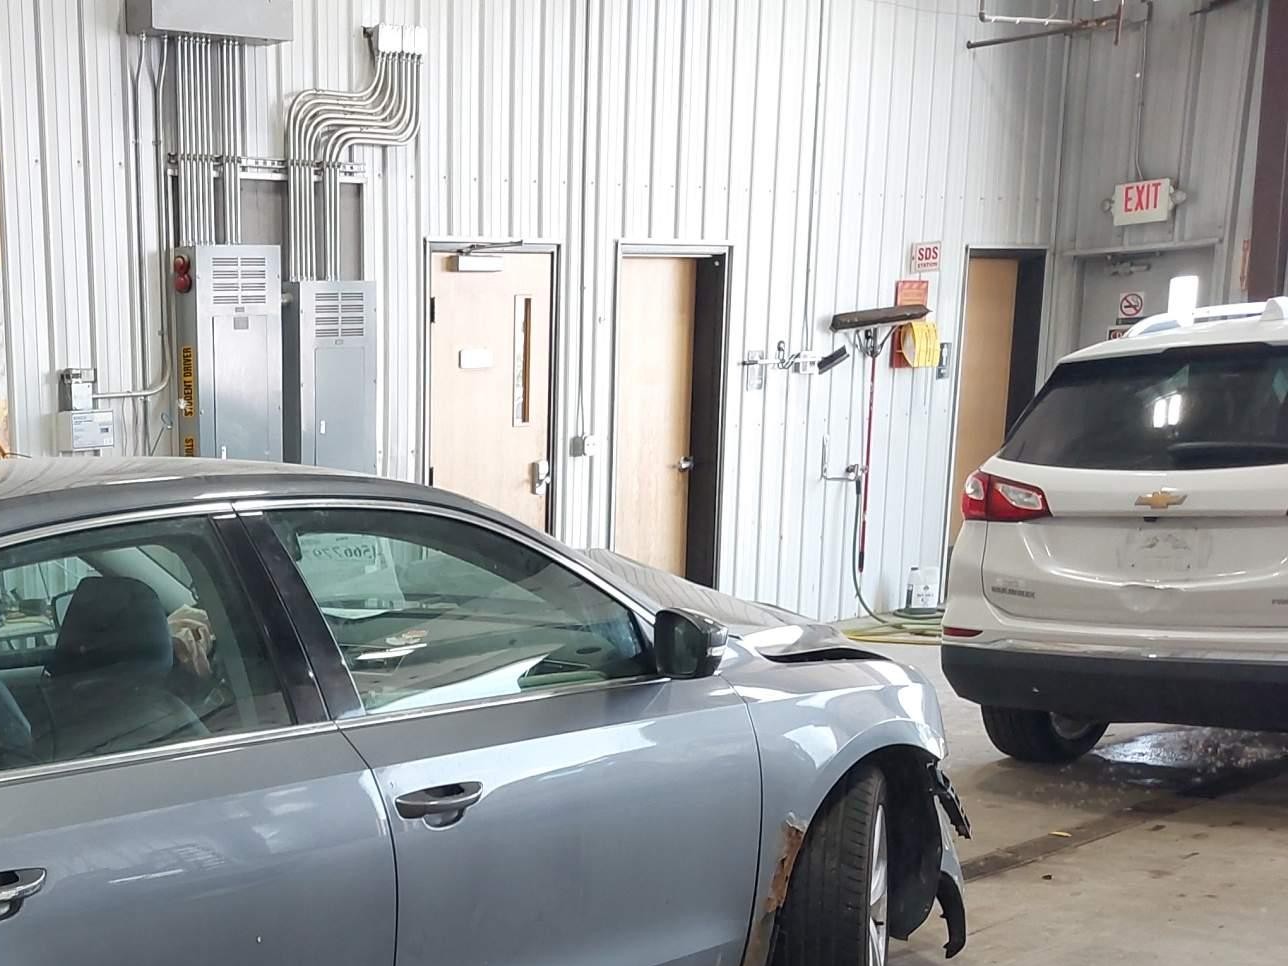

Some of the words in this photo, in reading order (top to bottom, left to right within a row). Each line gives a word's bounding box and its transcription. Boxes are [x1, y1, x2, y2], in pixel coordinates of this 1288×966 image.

[1124, 182, 1161, 213] EXIT
[917, 246, 938, 261] SDS
[183, 347, 192, 377] DRIVER
